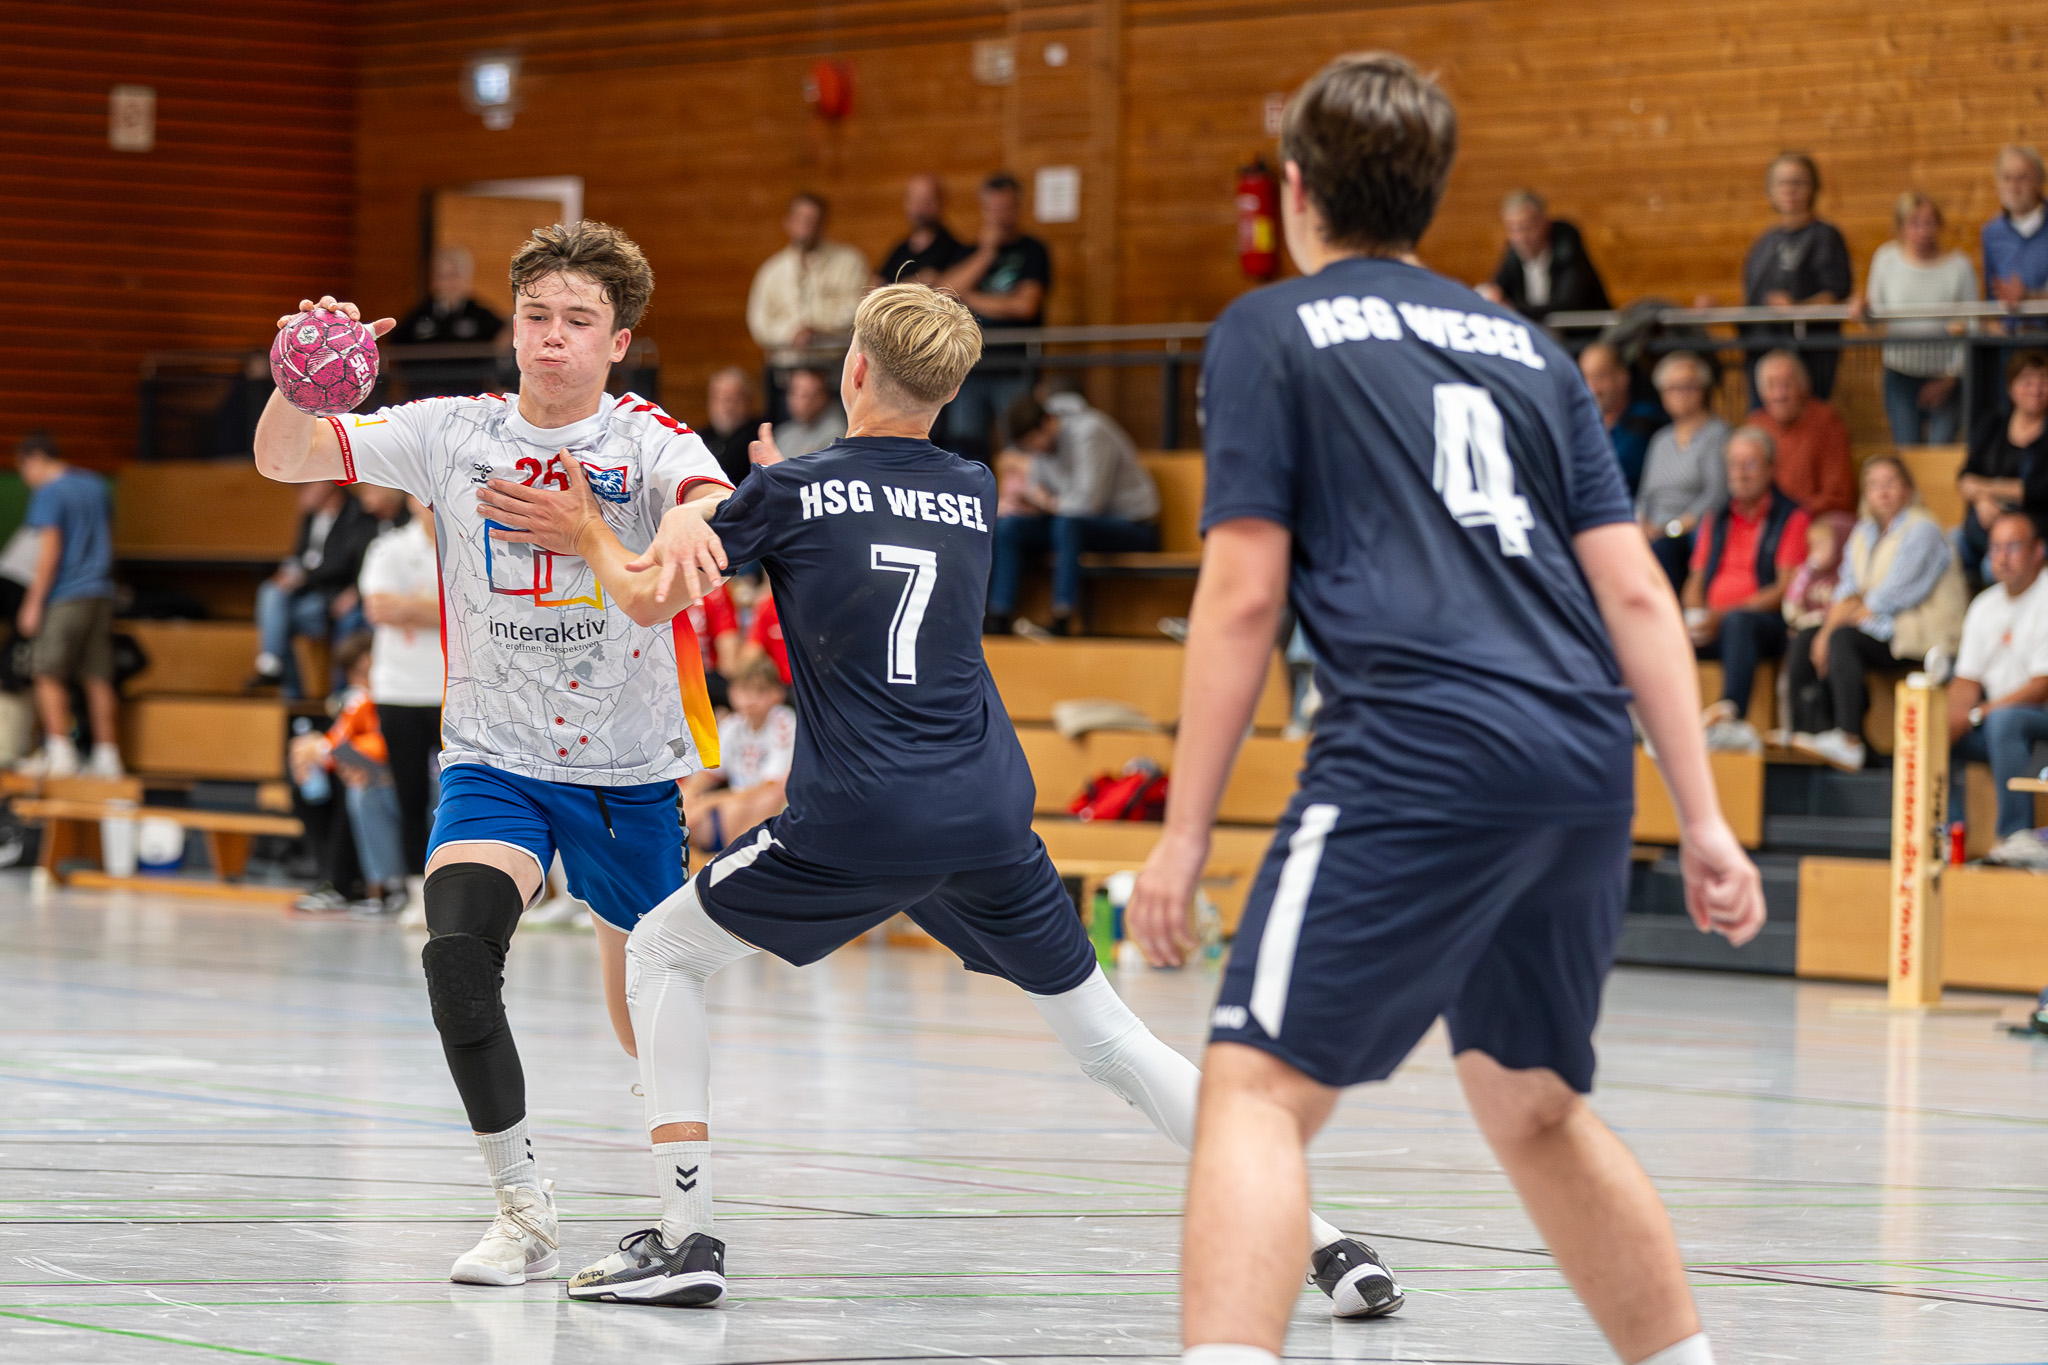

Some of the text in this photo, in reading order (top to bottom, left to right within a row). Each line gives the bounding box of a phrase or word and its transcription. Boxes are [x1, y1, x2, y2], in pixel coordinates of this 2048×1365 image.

[1297, 295, 1546, 370] HSG WESEL
[515, 454, 570, 491] 25
[1432, 382, 1536, 557] 4
[800, 479, 988, 532] HSG WESEL
[489, 615, 605, 643] interaktiv
[870, 544, 938, 685] 7
[545, 640, 600, 654] Perspektiven
[577, 1269, 605, 1281] Kempa
